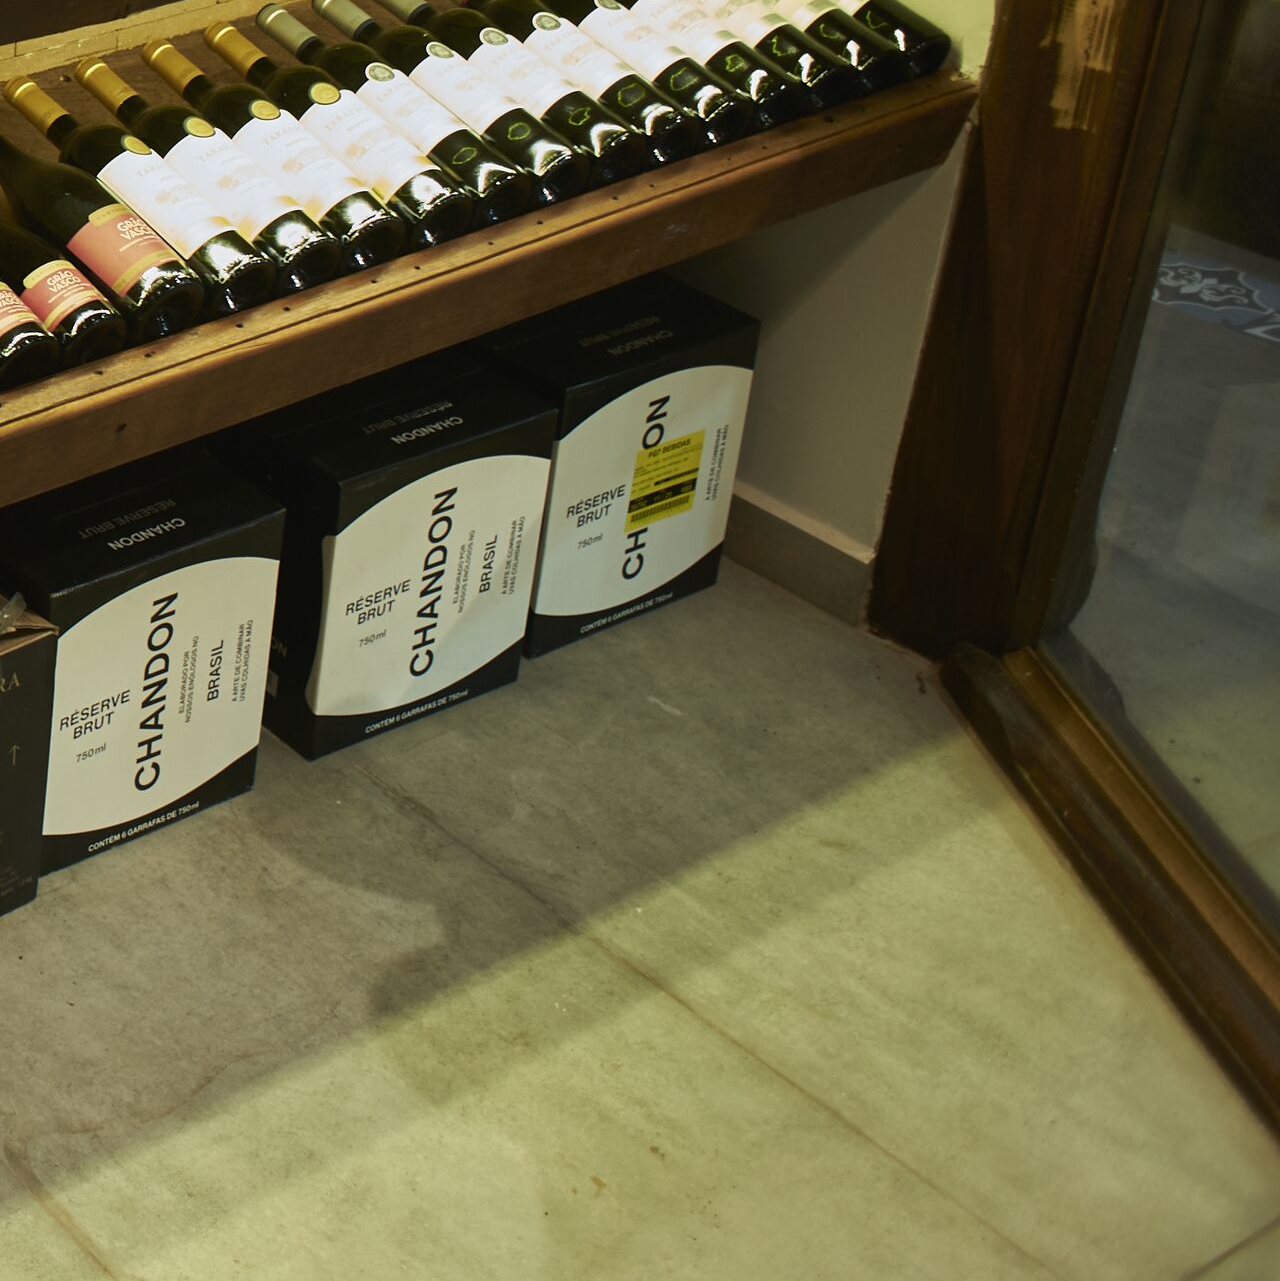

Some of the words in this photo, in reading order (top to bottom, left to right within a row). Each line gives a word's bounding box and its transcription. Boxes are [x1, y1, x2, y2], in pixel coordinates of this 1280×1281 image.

[566, 484, 627, 520] RÉSERVE
[576, 503, 612, 529] BRUT
[106, 517, 187, 552] CHANDON
[479, 534, 498, 594] BRASIL
[344, 578, 413, 617] RÉSERVE
[409, 486, 459, 679] CHANDON
[356, 600, 397, 626] BRUT
[358, 628, 388, 649] 750ml
[206, 639, 224, 702] BRASIL
[134, 591, 180, 793] CHANDON
[401, 701, 437, 720] GARRAFAS
[437, 697, 447, 707] DE
[58, 689, 132, 732] RÉSERVE
[72, 711, 116, 740] BRUT
[75, 742, 108, 764] 750ml
[88, 831, 121, 853] CONTÉM
[127, 814, 166, 837] GARRAFAS
[166, 810, 177, 821] DE
[178, 800, 200, 817] 750ml
